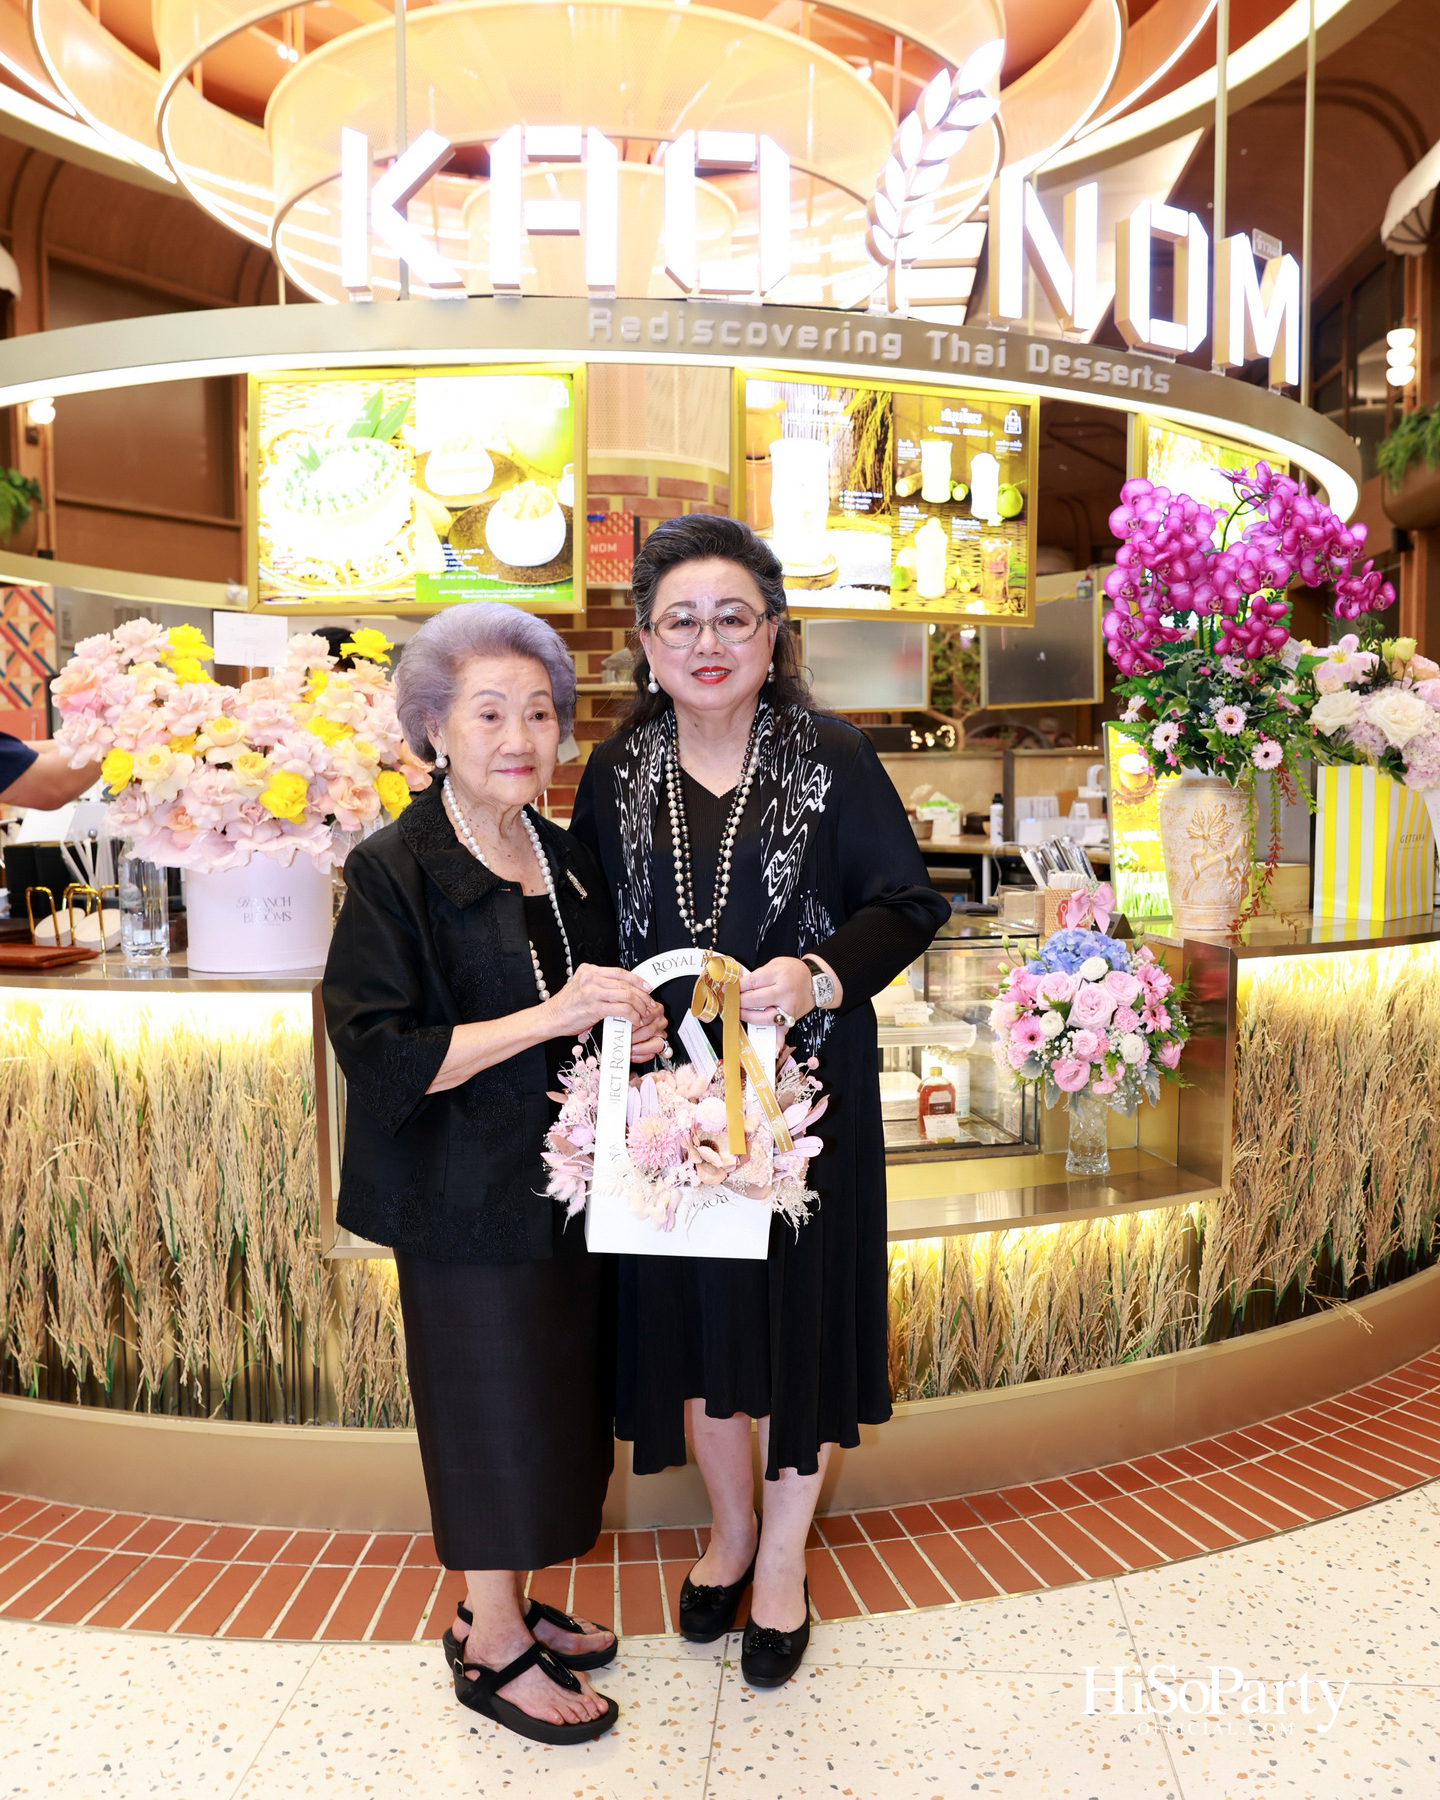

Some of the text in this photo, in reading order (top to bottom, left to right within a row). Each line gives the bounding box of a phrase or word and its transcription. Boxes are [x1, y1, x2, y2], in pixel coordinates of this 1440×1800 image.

[990, 167, 1301, 387] NOM
[588, 306, 1171, 394] Rediscovering Thai Desserts
[590, 542, 618, 553] NOM
[651, 955, 696, 976] ROYAL
[609, 1027, 625, 1070] ROYAL
[609, 1073, 623, 1108] JECT
